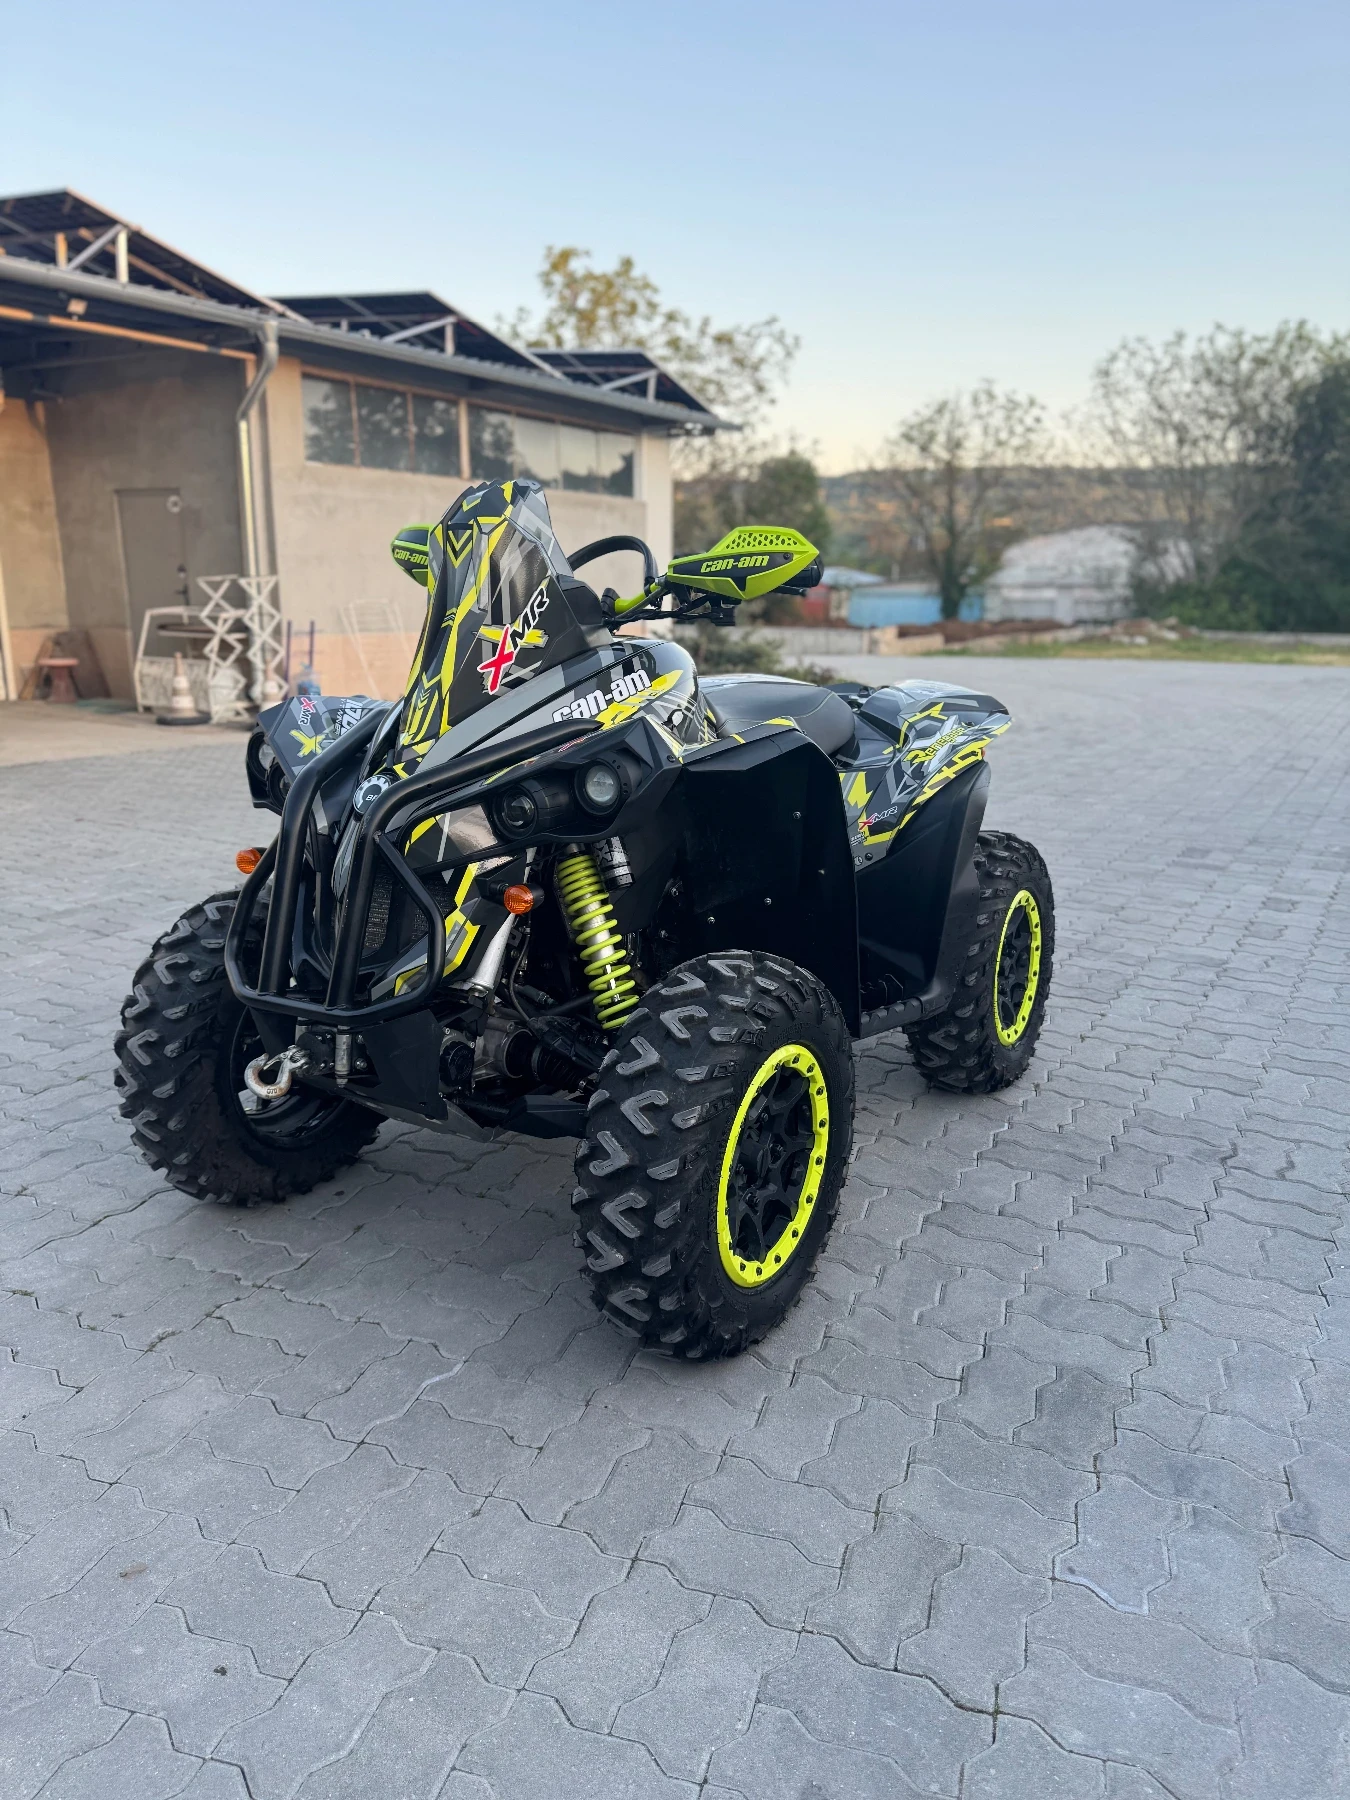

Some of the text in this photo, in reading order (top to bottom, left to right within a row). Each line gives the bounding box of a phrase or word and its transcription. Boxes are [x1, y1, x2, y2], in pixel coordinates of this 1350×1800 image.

[394, 549, 429, 566] can-am
[700, 555, 770, 573] can-am
[552, 669, 652, 723] can-am
